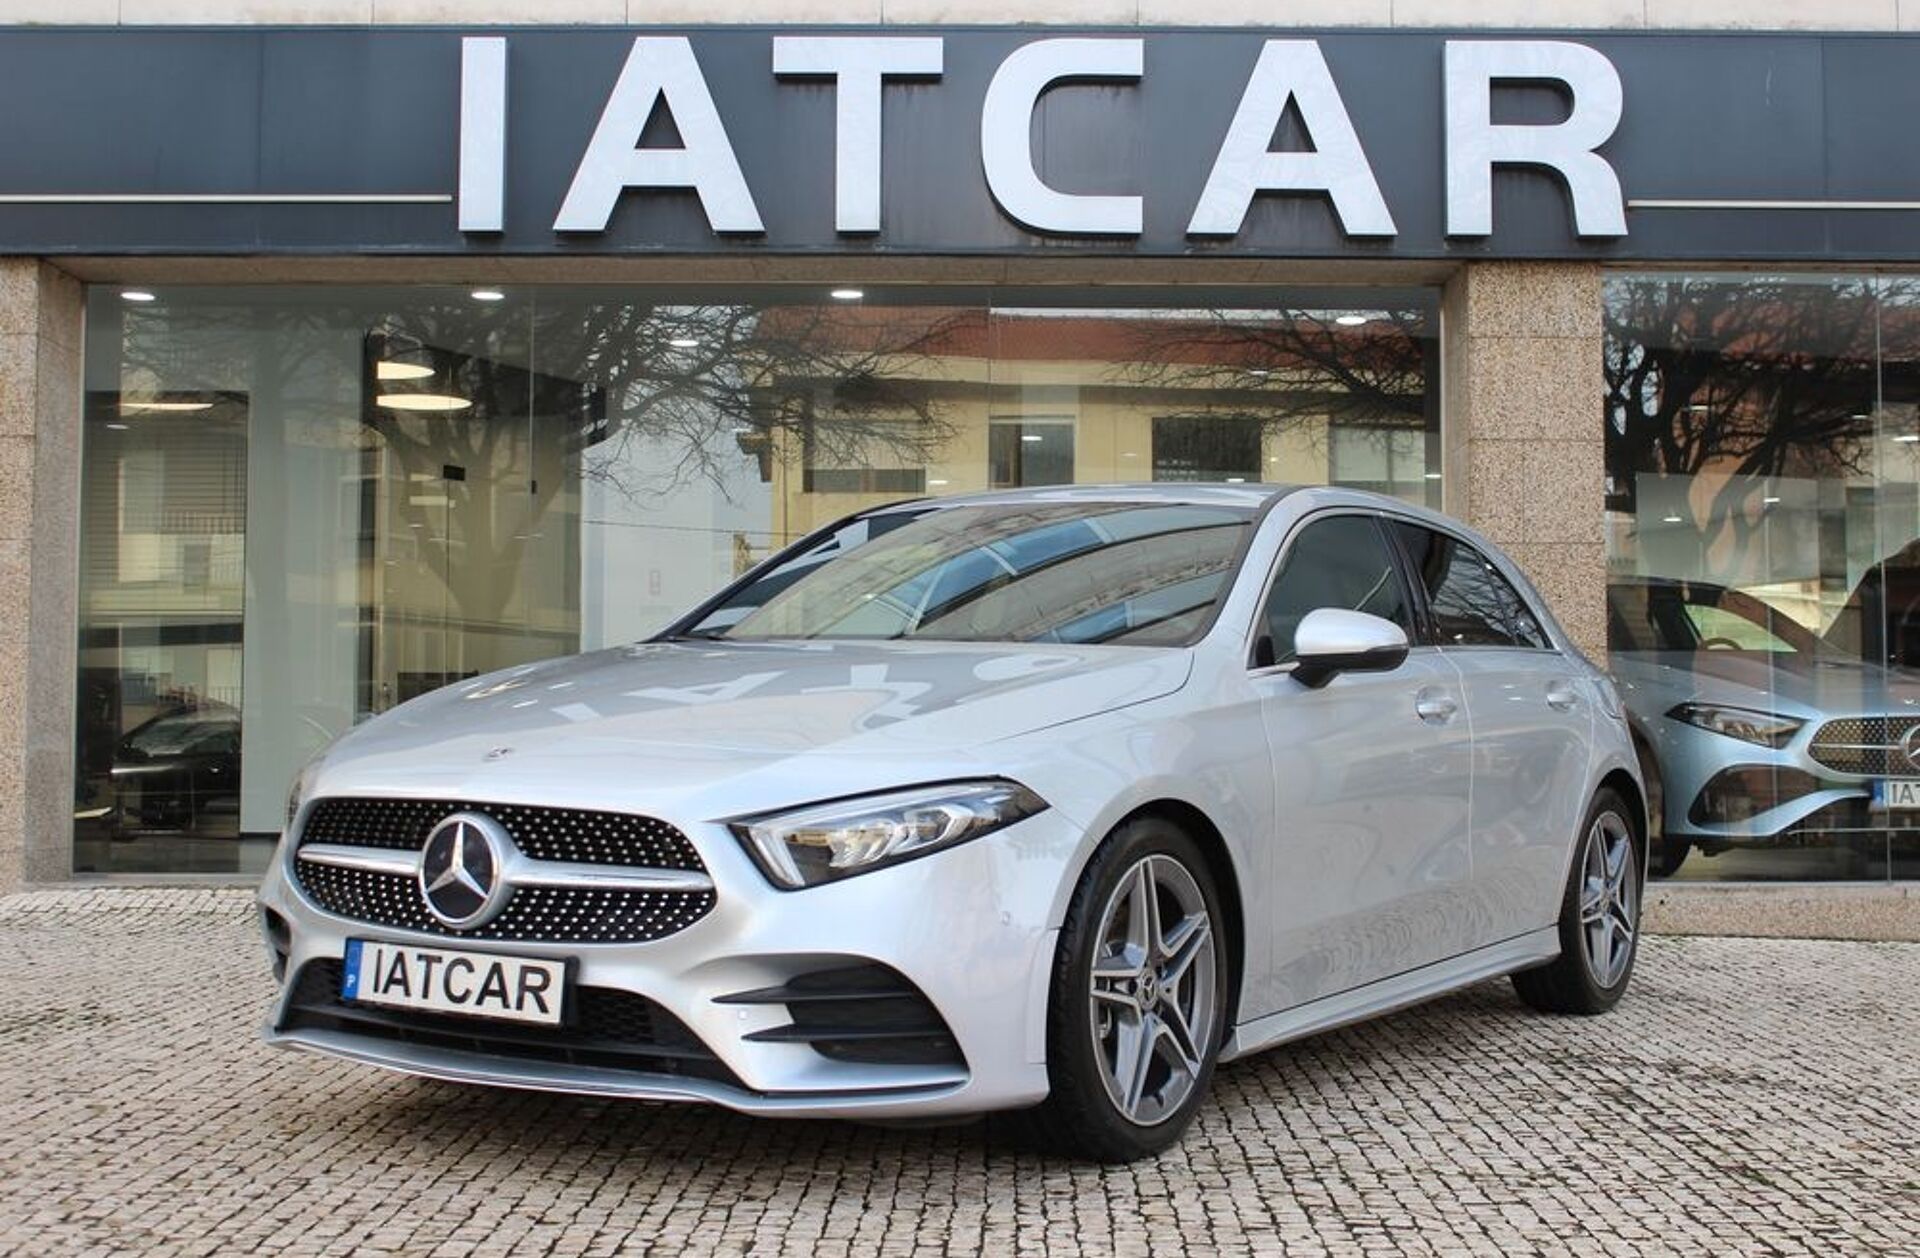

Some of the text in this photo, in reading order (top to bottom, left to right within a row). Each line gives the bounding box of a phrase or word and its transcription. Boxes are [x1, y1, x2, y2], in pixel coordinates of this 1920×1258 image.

[458, 36, 1628, 235] IATCAR
[347, 974, 356, 988] P
[373, 949, 551, 1014] IATCAR
